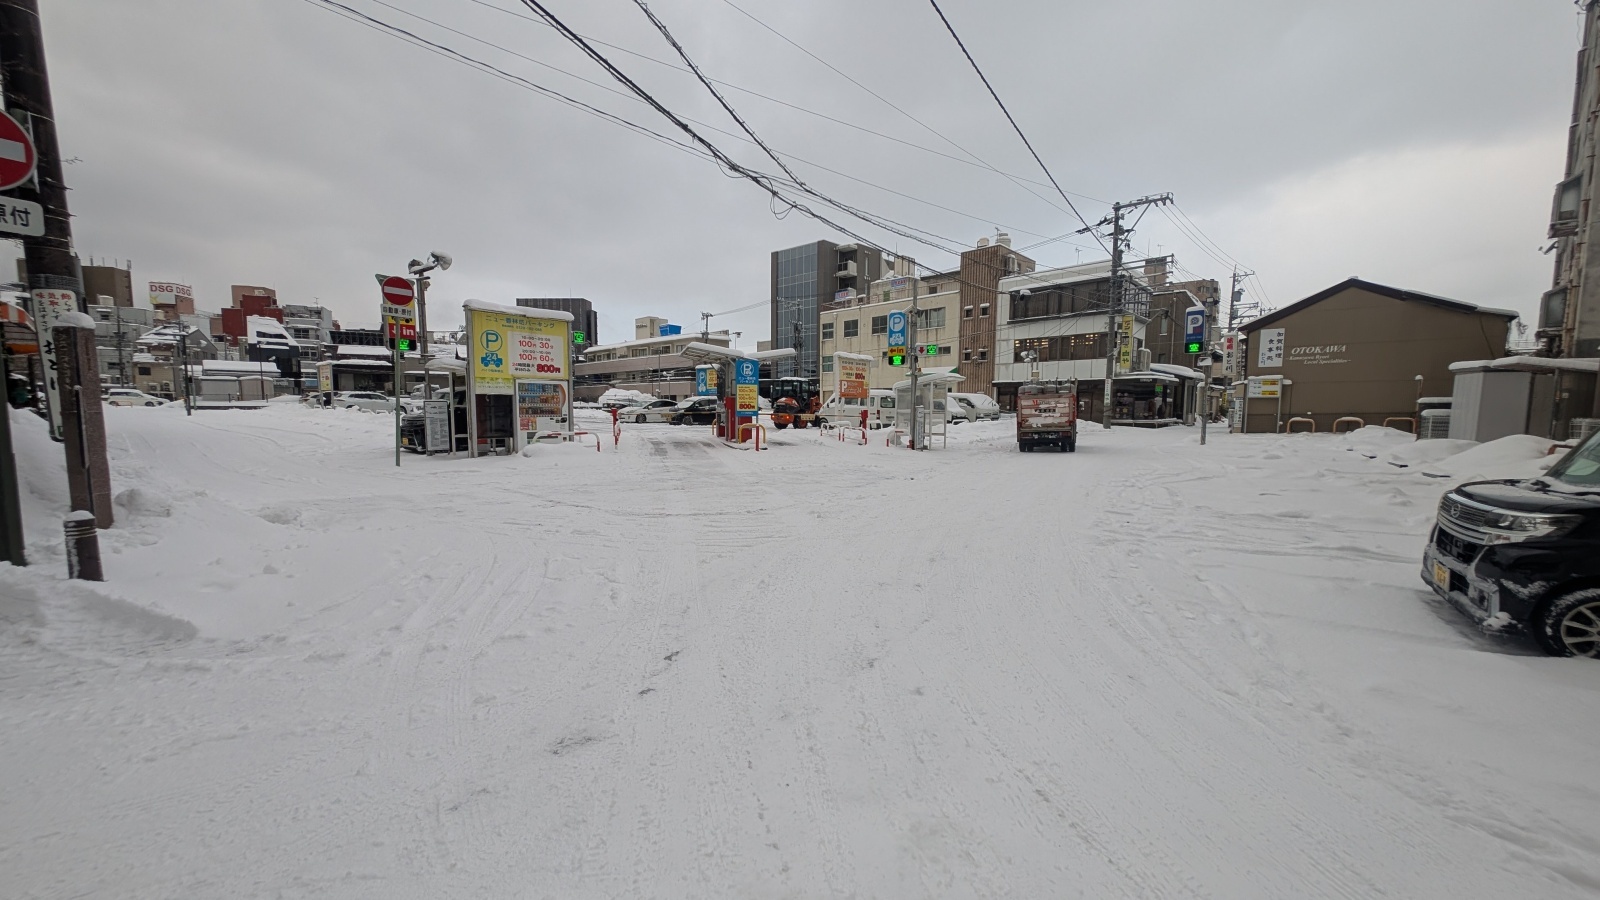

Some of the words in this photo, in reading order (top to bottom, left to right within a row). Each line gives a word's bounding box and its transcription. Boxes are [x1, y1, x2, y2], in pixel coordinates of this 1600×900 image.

[150, 285, 173, 293] DSG
[176, 287, 191, 296] DSG
[403, 327, 414, 336] in
[1291, 345, 1346, 355] OTOKAWA
